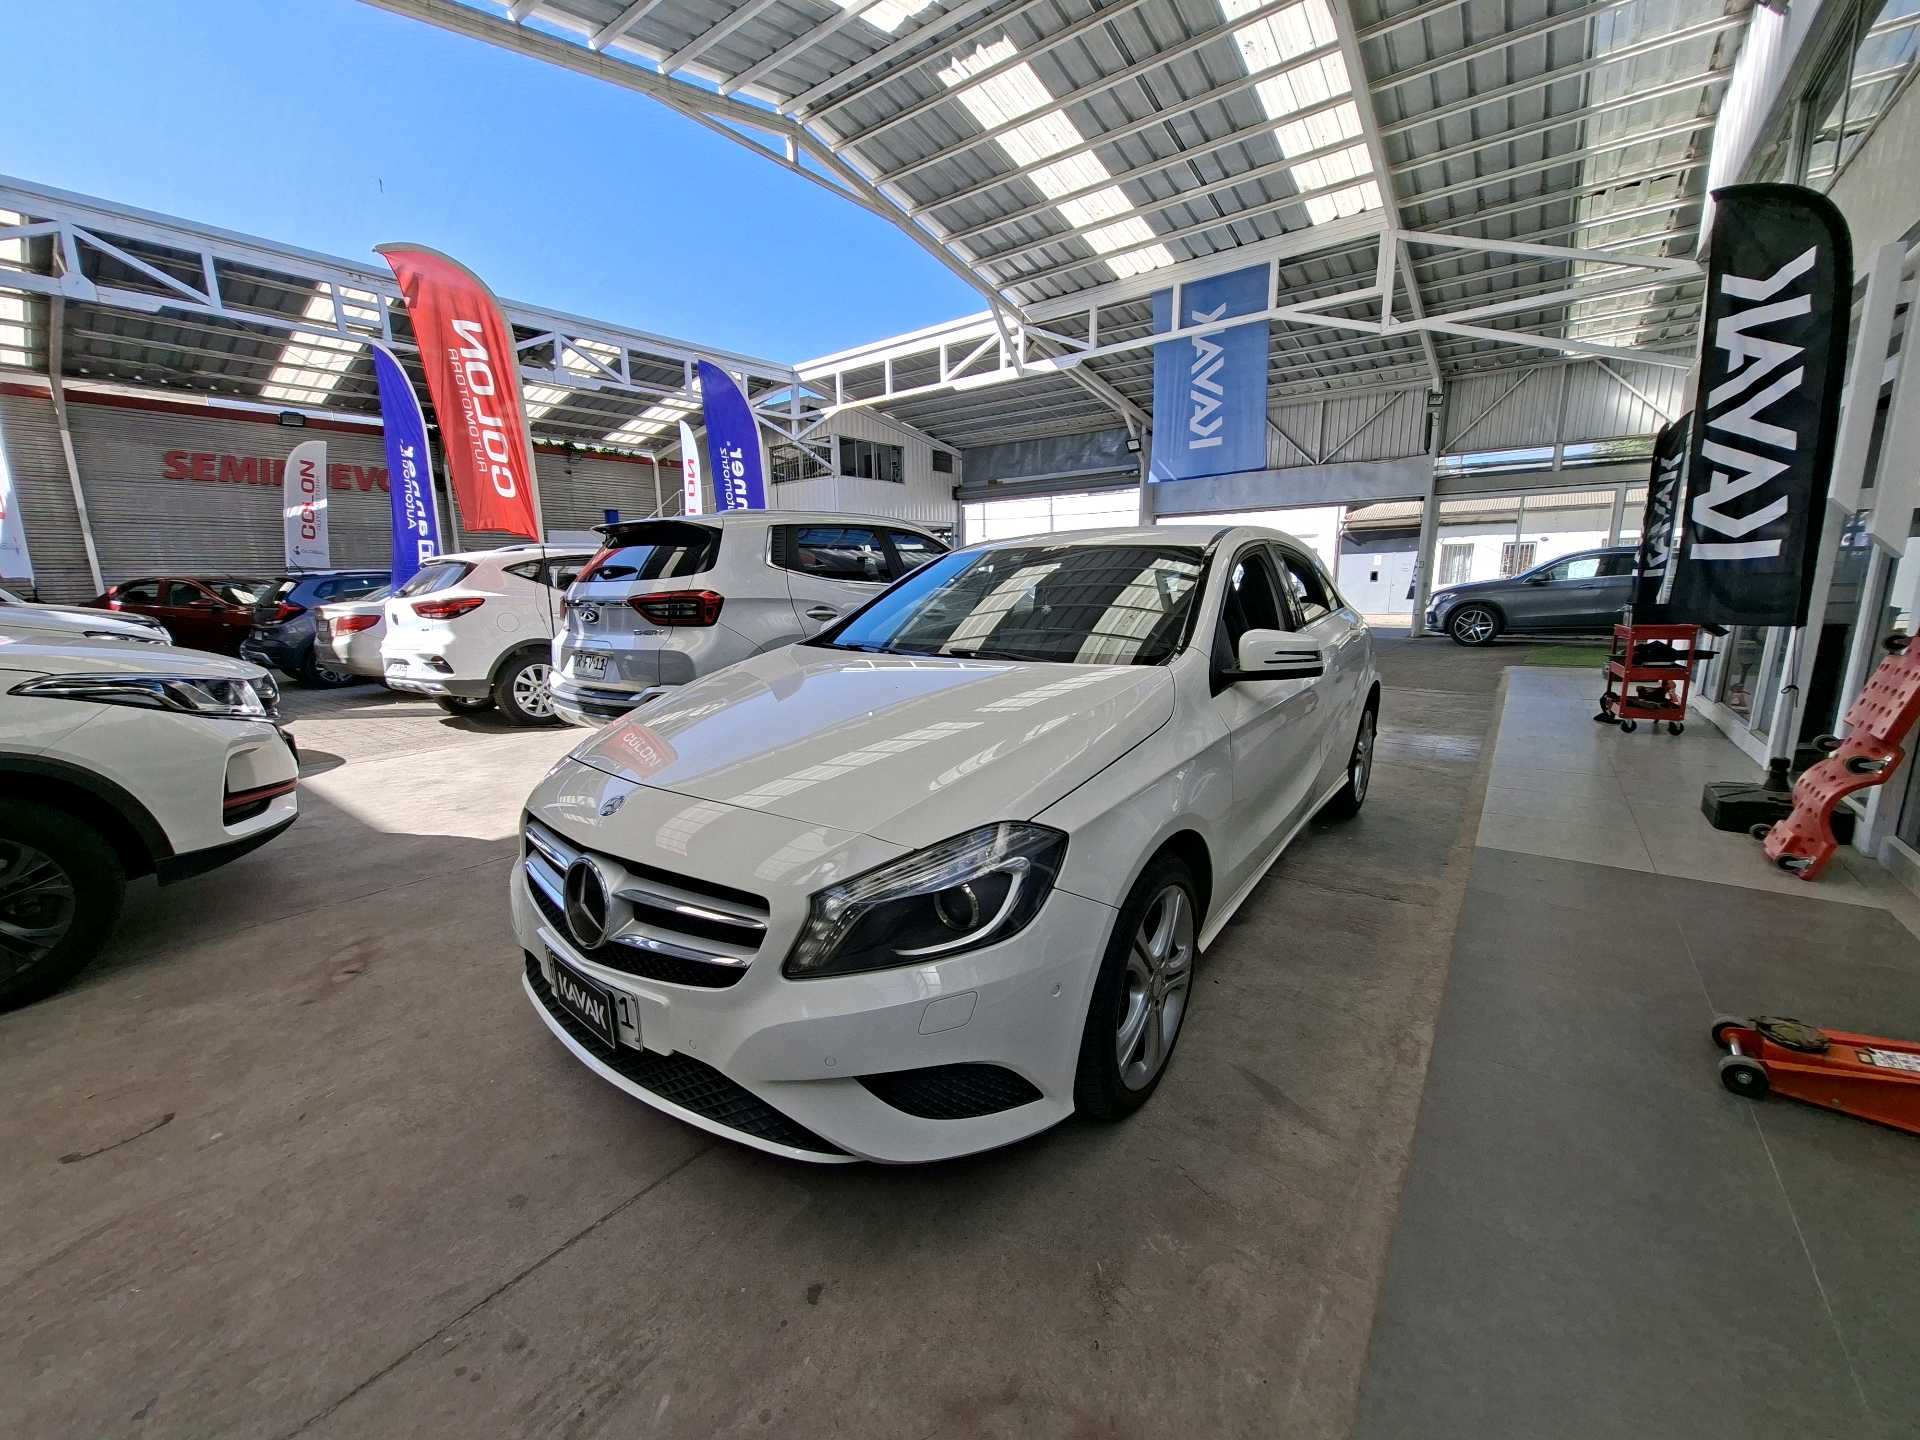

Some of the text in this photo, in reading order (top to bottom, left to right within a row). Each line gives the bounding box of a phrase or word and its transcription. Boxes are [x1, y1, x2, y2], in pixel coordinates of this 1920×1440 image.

[1188, 302, 1228, 451] KAVAK
[1690, 245, 1817, 560] KAVAK
[300, 459, 317, 540] COLON
[558, 971, 608, 1031] KAVAK
